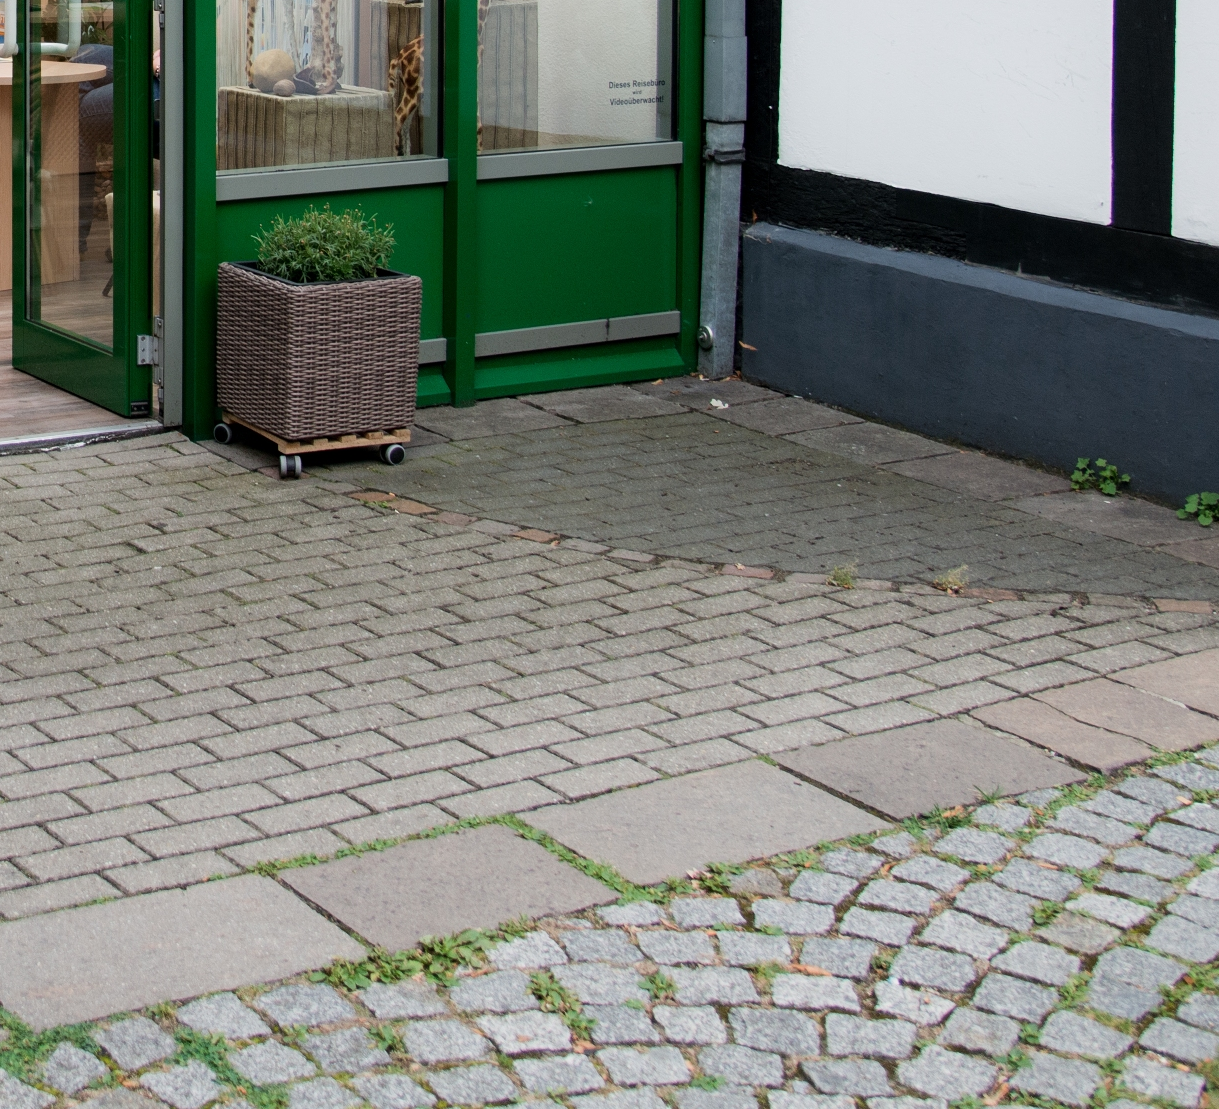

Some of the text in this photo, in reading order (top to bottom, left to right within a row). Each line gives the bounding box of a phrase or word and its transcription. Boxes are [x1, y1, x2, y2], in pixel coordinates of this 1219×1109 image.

[608, 78, 666, 89] Dieses Reisebüro
[609, 95, 664, 106] Videoüberwacht!
